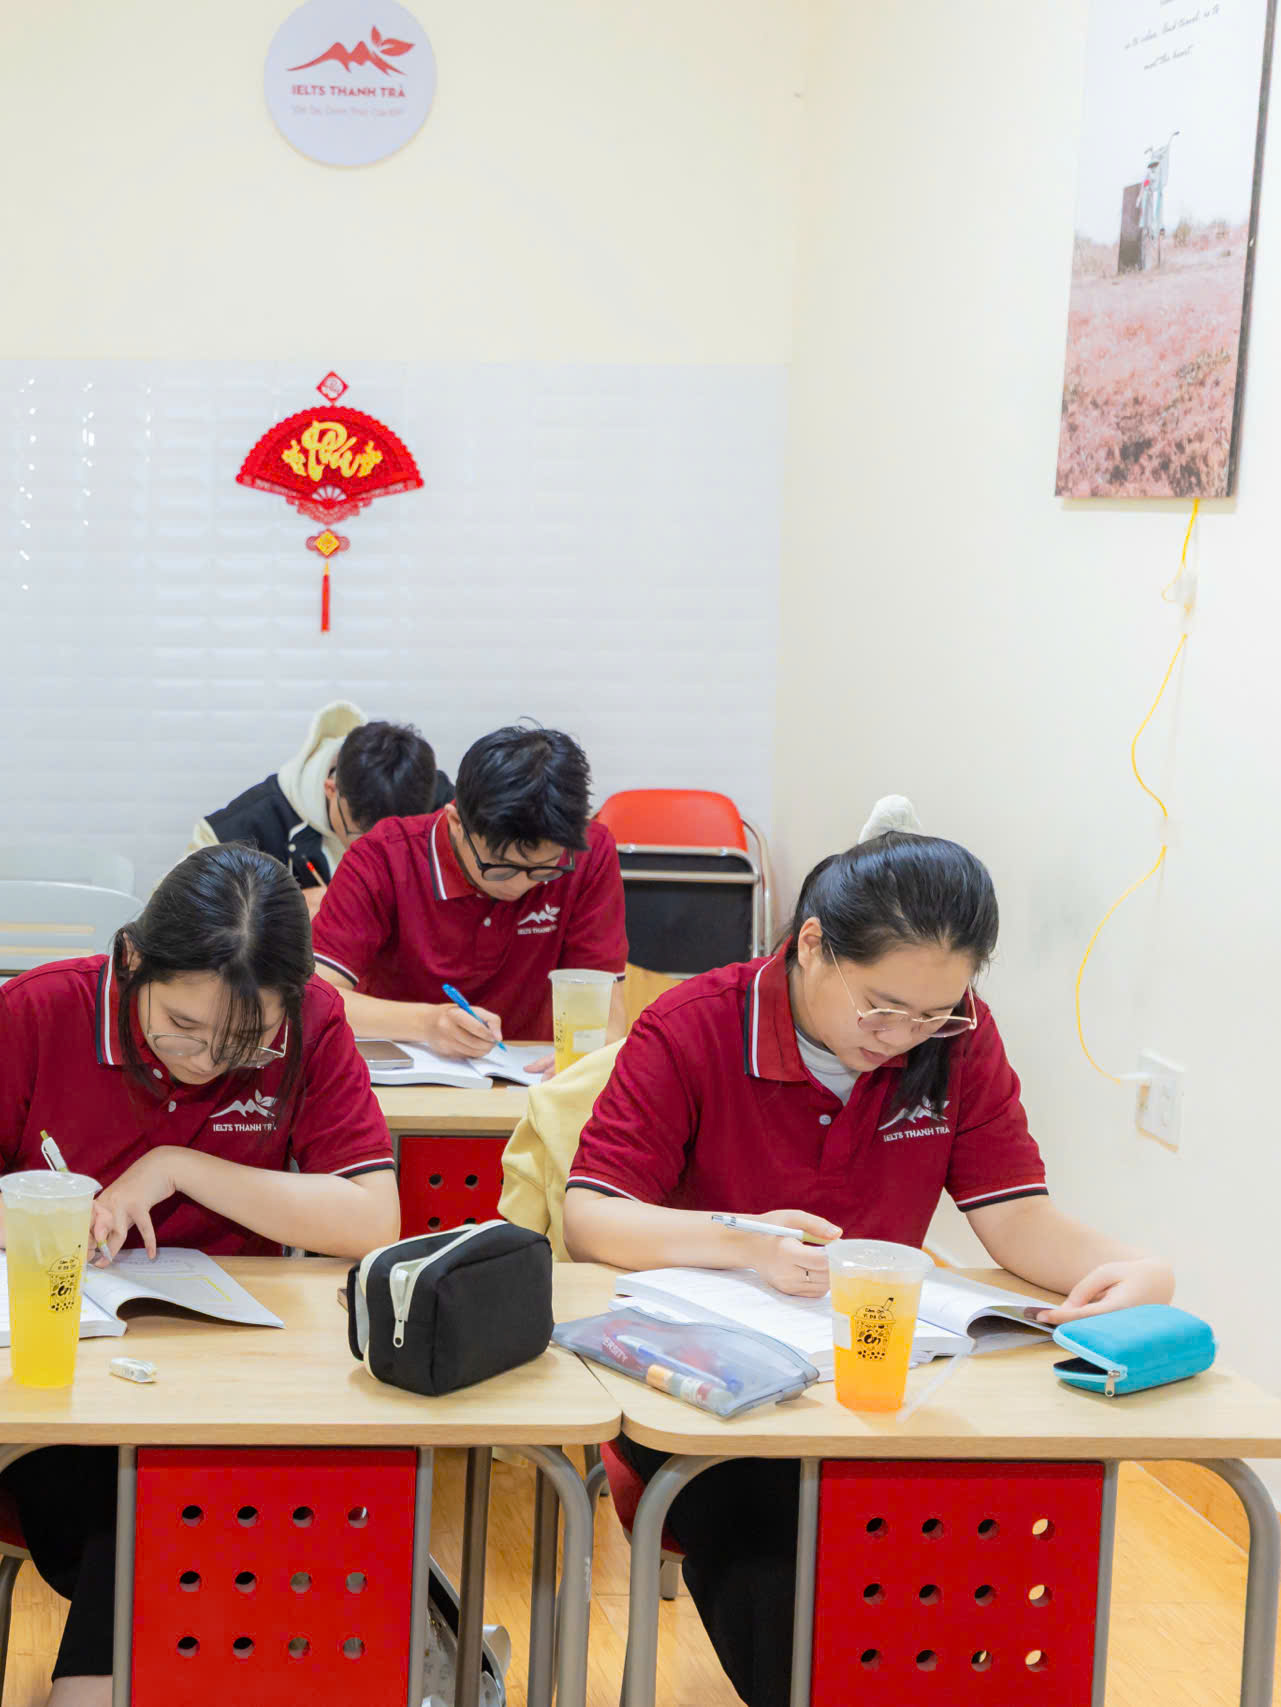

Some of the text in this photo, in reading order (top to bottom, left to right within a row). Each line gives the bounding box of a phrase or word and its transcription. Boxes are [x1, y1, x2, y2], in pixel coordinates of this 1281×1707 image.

[291, 84, 326, 96] IELTS
[329, 84, 377, 97] THANH
[213, 1123, 234, 1132] IELTS
[235, 1123, 262, 1132] THANH
[883, 1131, 904, 1142] IELTS
[904, 1127, 934, 1139] THANH
